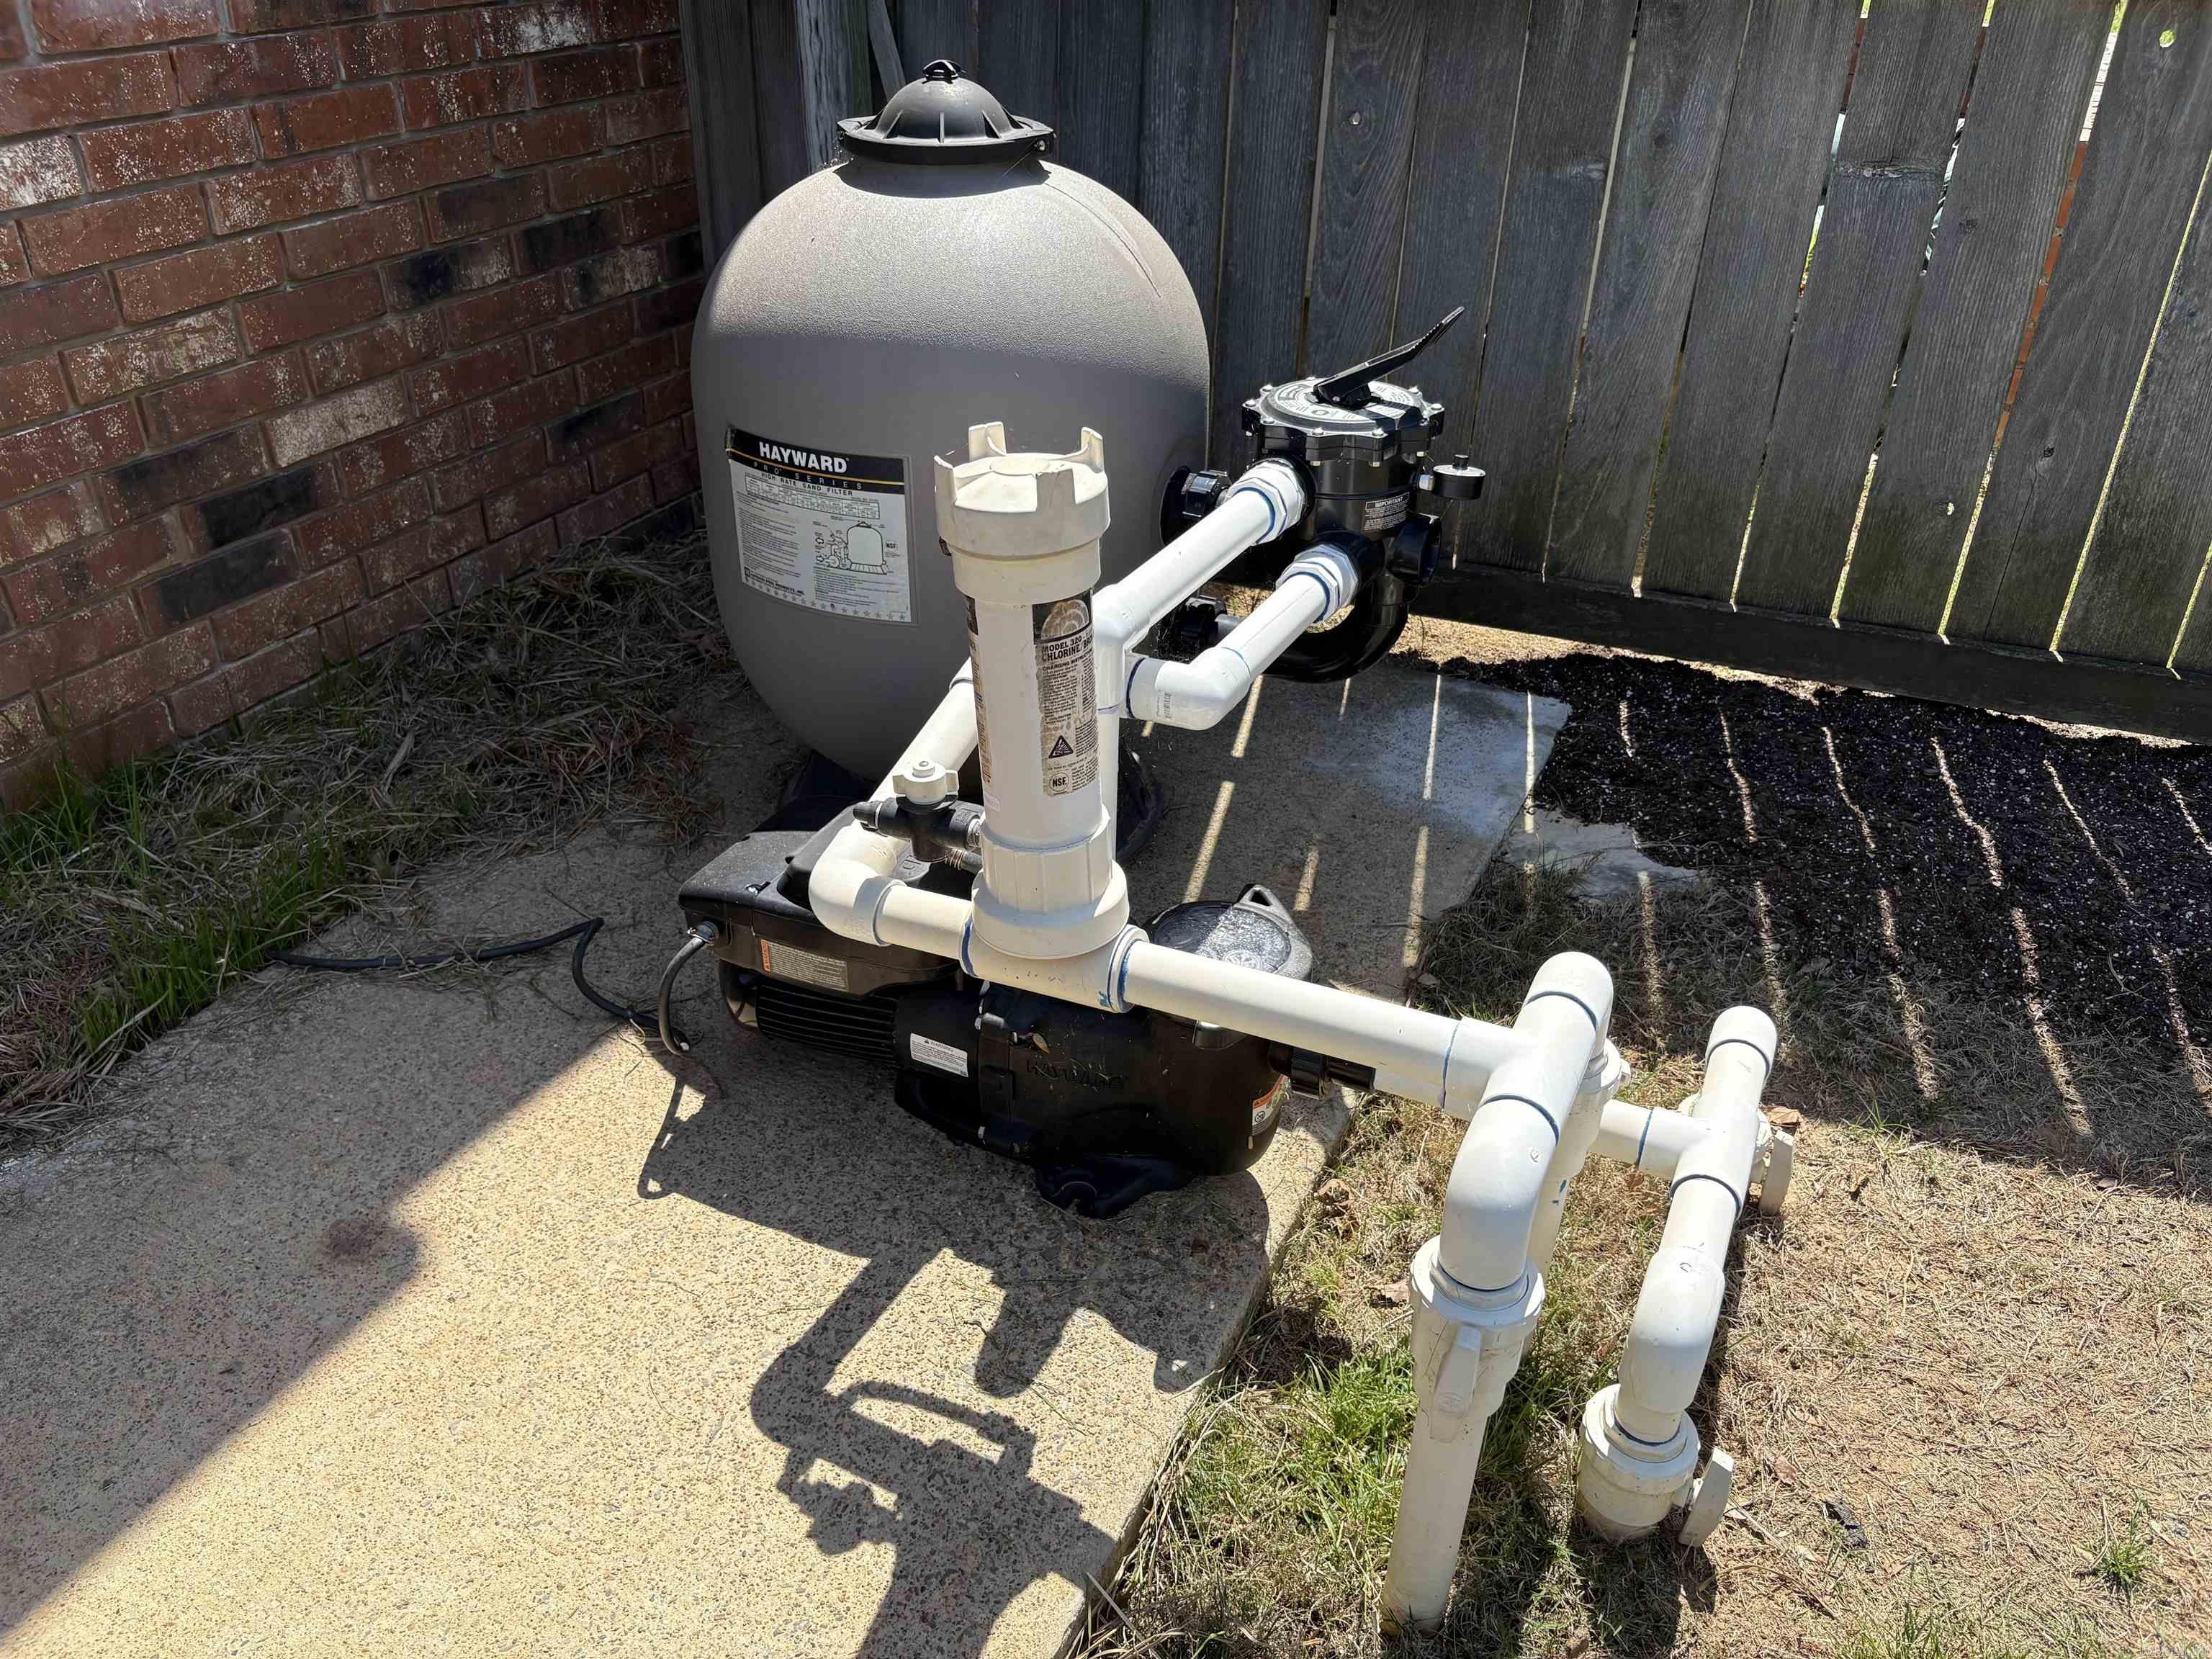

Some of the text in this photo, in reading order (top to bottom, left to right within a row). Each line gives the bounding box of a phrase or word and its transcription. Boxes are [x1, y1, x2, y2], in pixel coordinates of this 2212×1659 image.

[758, 441, 848, 473] HAYWARD
[761, 472, 853, 496] HIGH RATE SAND FILTER
[794, 472, 863, 490] SERIES
[1042, 635, 1082, 653] MODEL 320
